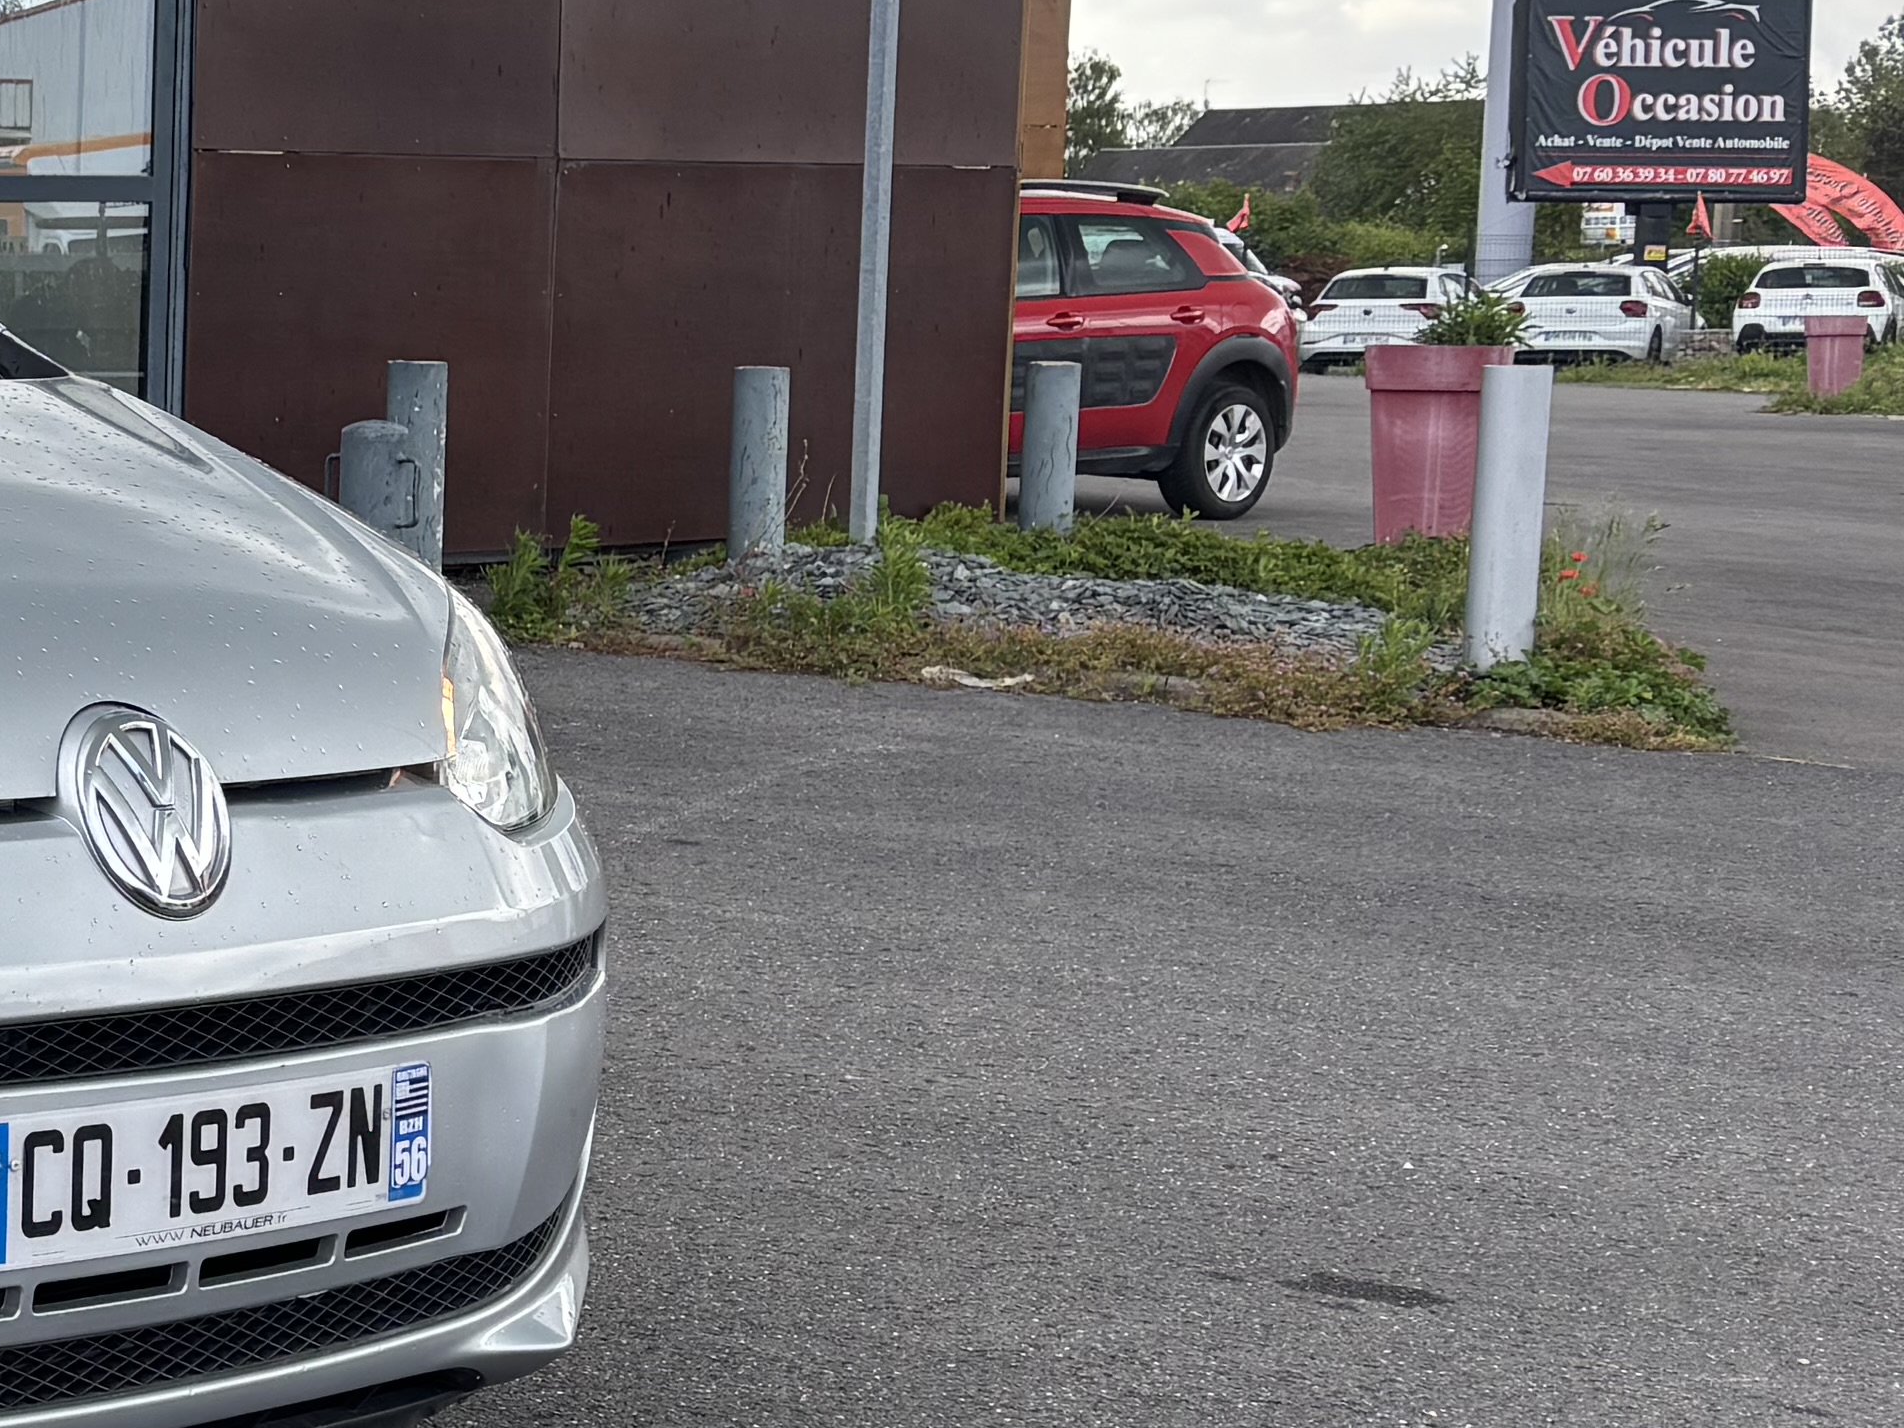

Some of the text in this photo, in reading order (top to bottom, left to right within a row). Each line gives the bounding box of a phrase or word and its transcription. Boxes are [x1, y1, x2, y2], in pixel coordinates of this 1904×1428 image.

[1547, 15, 1756, 70] Véhicule
[1577, 74, 1786, 126] Occasion
[1535, 134, 1575, 147] Achat
[1586, 134, 1623, 148] Vente
[1676, 136, 1713, 149] Vente
[1714, 137, 1791, 150] Automobile
[399, 1115, 424, 1136] BZH
[394, 1135, 428, 1186] 56
